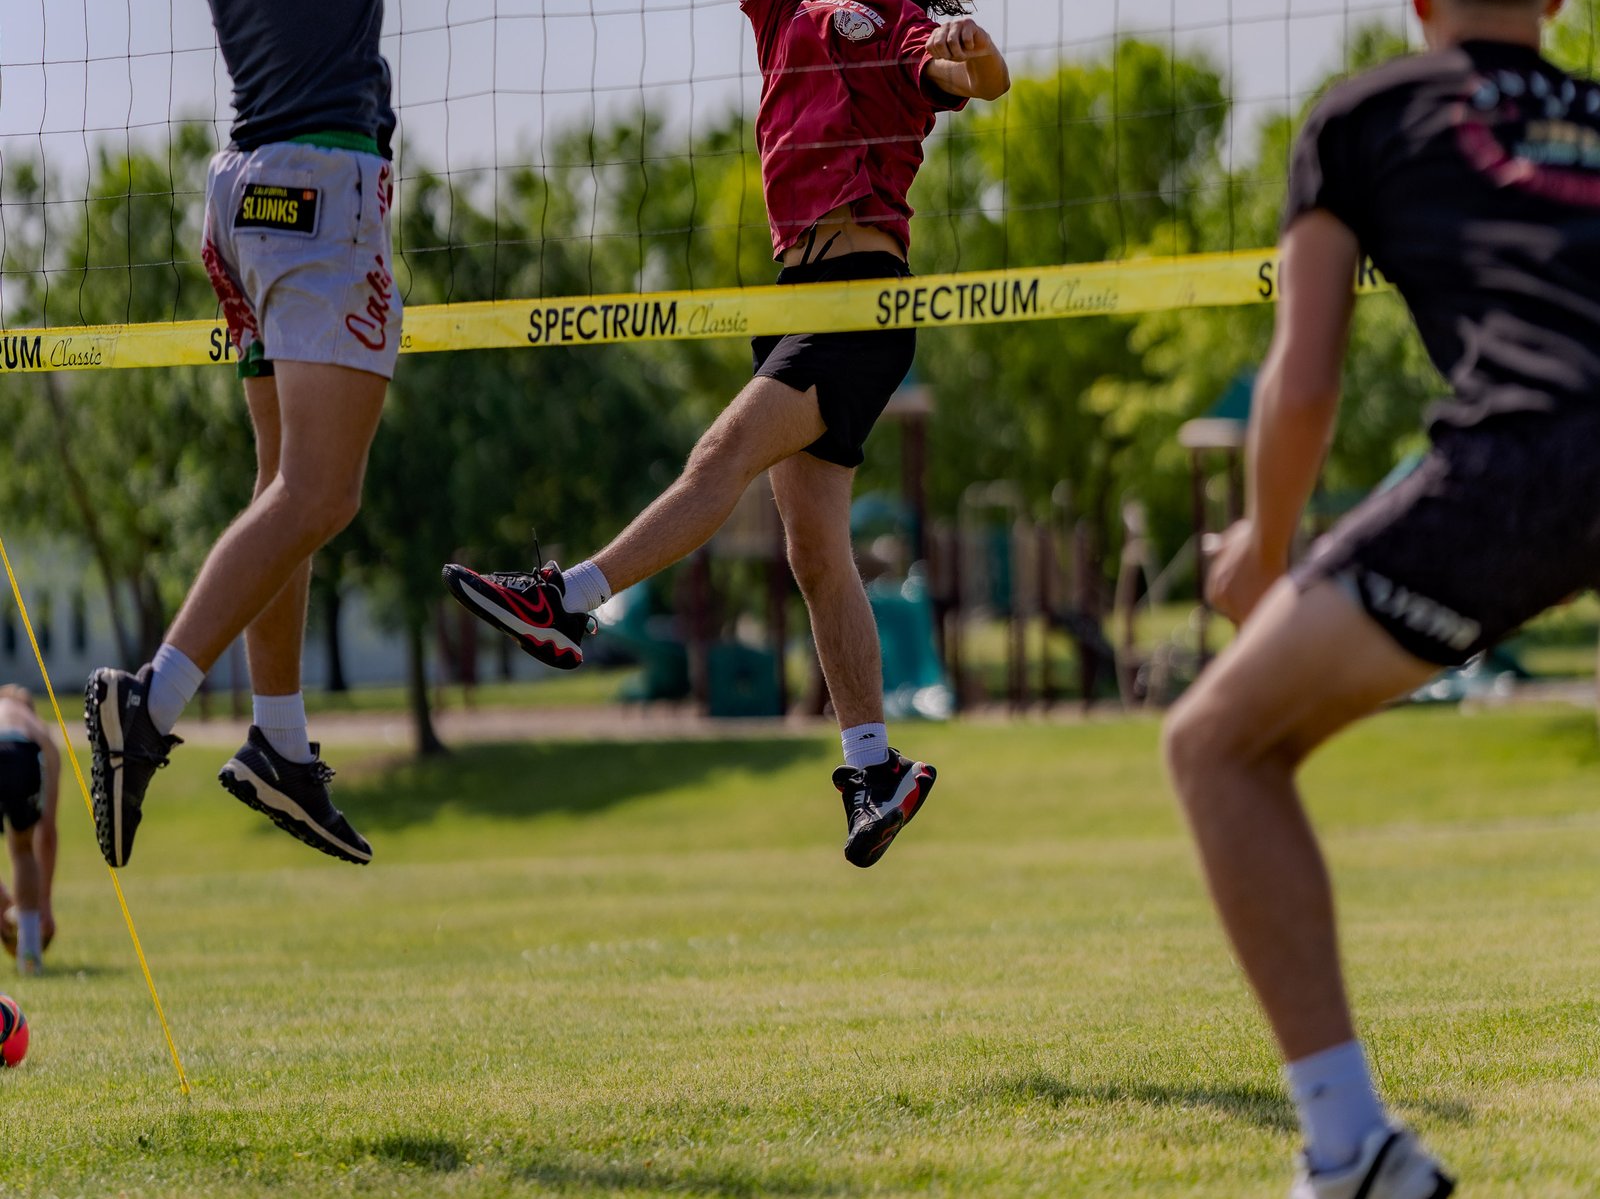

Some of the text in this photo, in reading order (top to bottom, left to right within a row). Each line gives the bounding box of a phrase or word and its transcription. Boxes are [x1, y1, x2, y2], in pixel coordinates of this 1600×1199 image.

[242, 196, 299, 224] SLUNKS
[877, 276, 1119, 326] SPECTRUM Classic
[528, 301, 749, 343] SPECTRUM Classic
[0, 336, 103, 369] UM Classic
